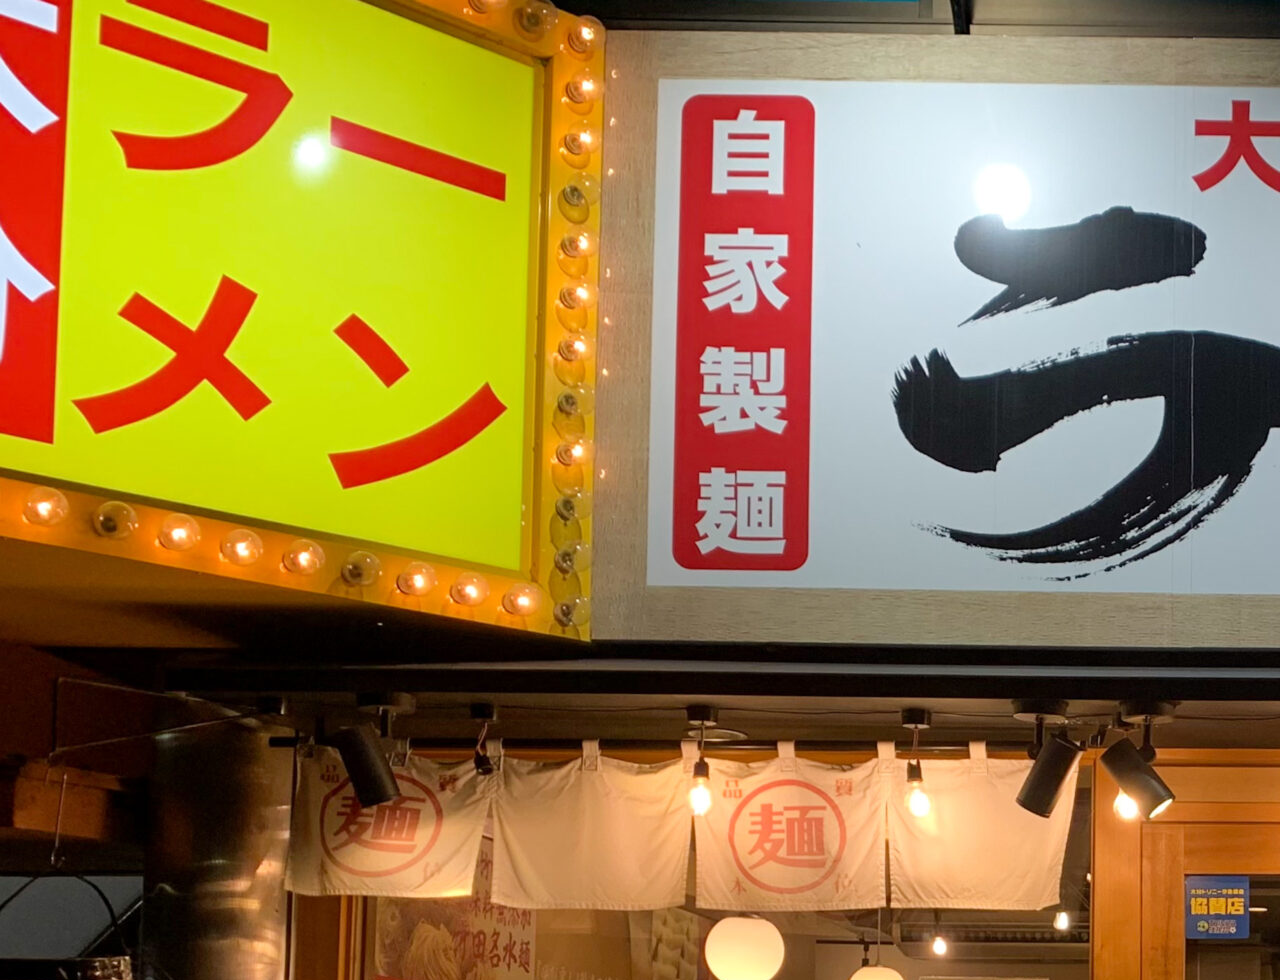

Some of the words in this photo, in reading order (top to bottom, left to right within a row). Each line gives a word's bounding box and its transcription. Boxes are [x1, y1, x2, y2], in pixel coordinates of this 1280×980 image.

[99, 0, 507, 201] ラー
[73, 274, 508, 490] メン
[695, 108, 790, 557] 自家製麺
[334, 794, 427, 855] 麺
[747, 803, 828, 870] 麺
